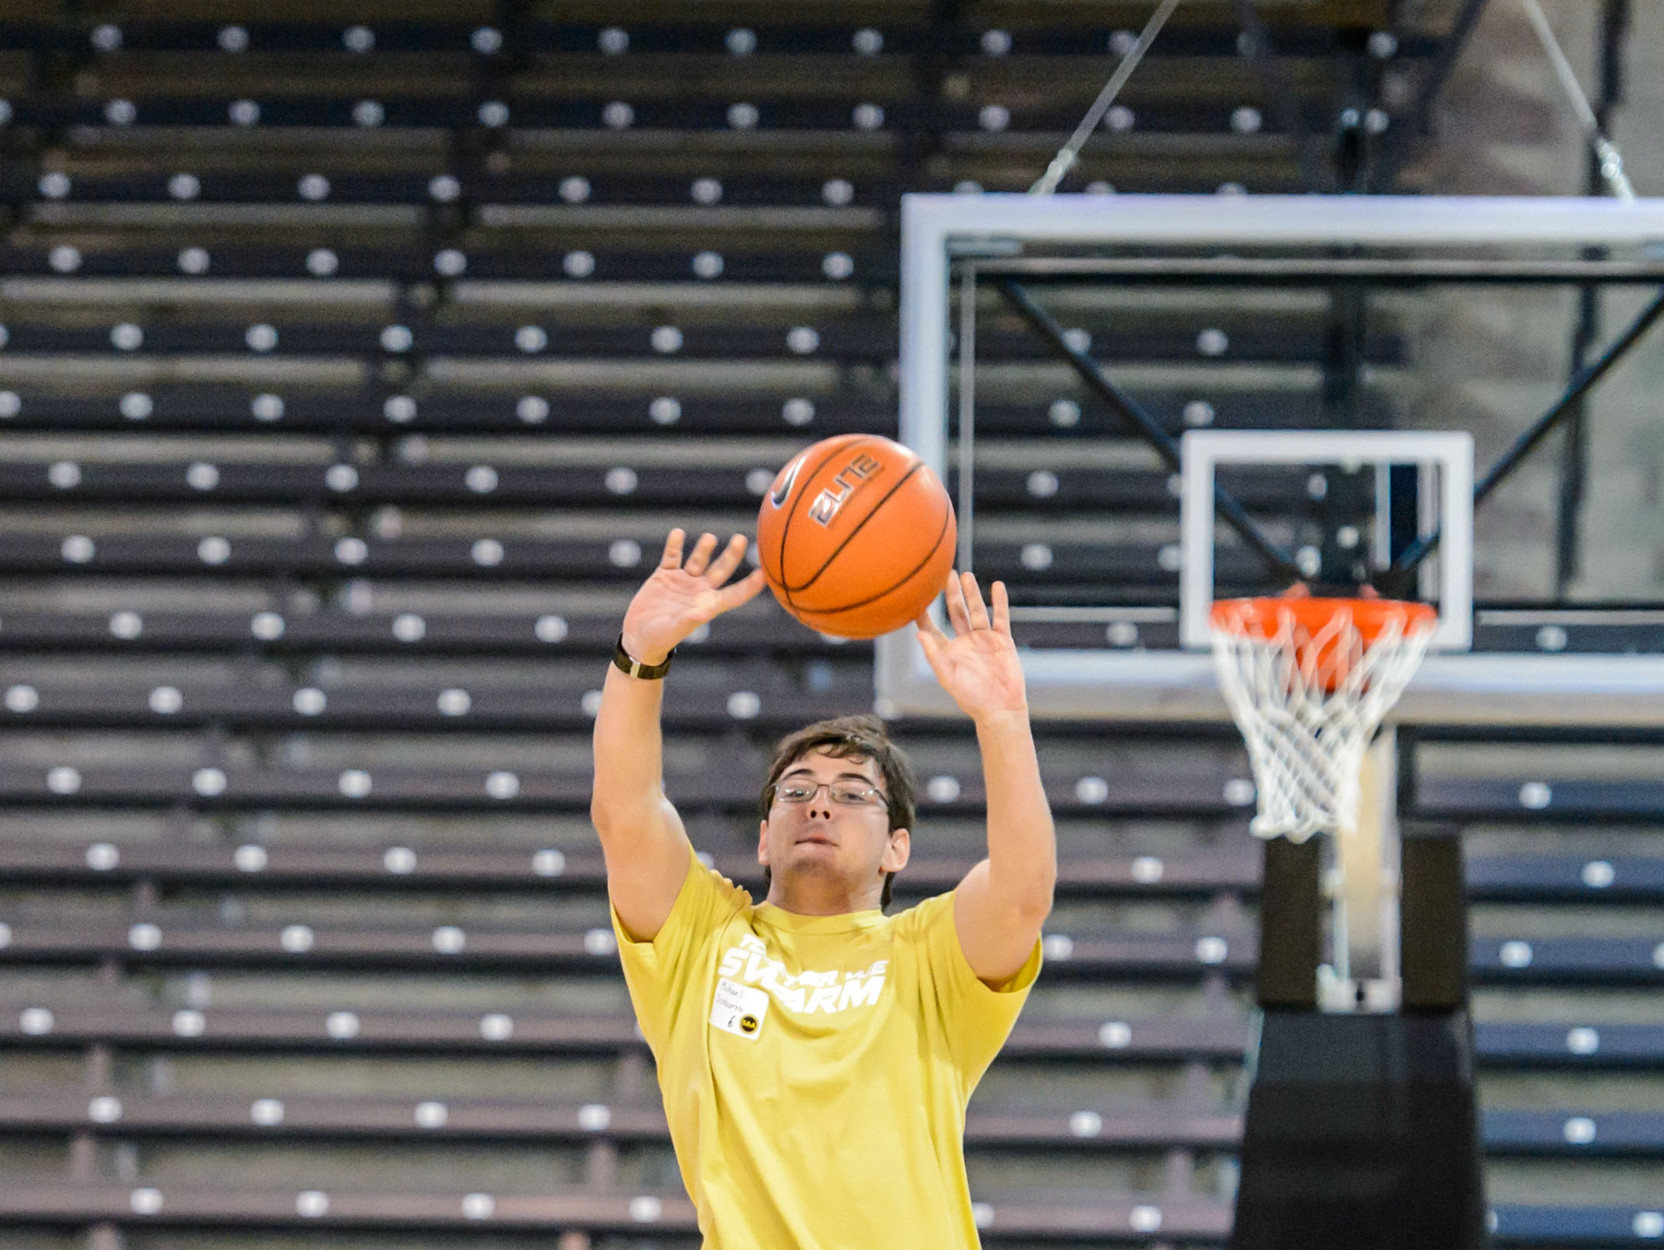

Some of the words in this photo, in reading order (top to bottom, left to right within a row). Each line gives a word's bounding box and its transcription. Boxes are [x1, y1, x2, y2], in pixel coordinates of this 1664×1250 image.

[808, 453, 880, 528] ELITE
[718, 947, 886, 1014] SWARM
[727, 1015, 736, 1028] 6
